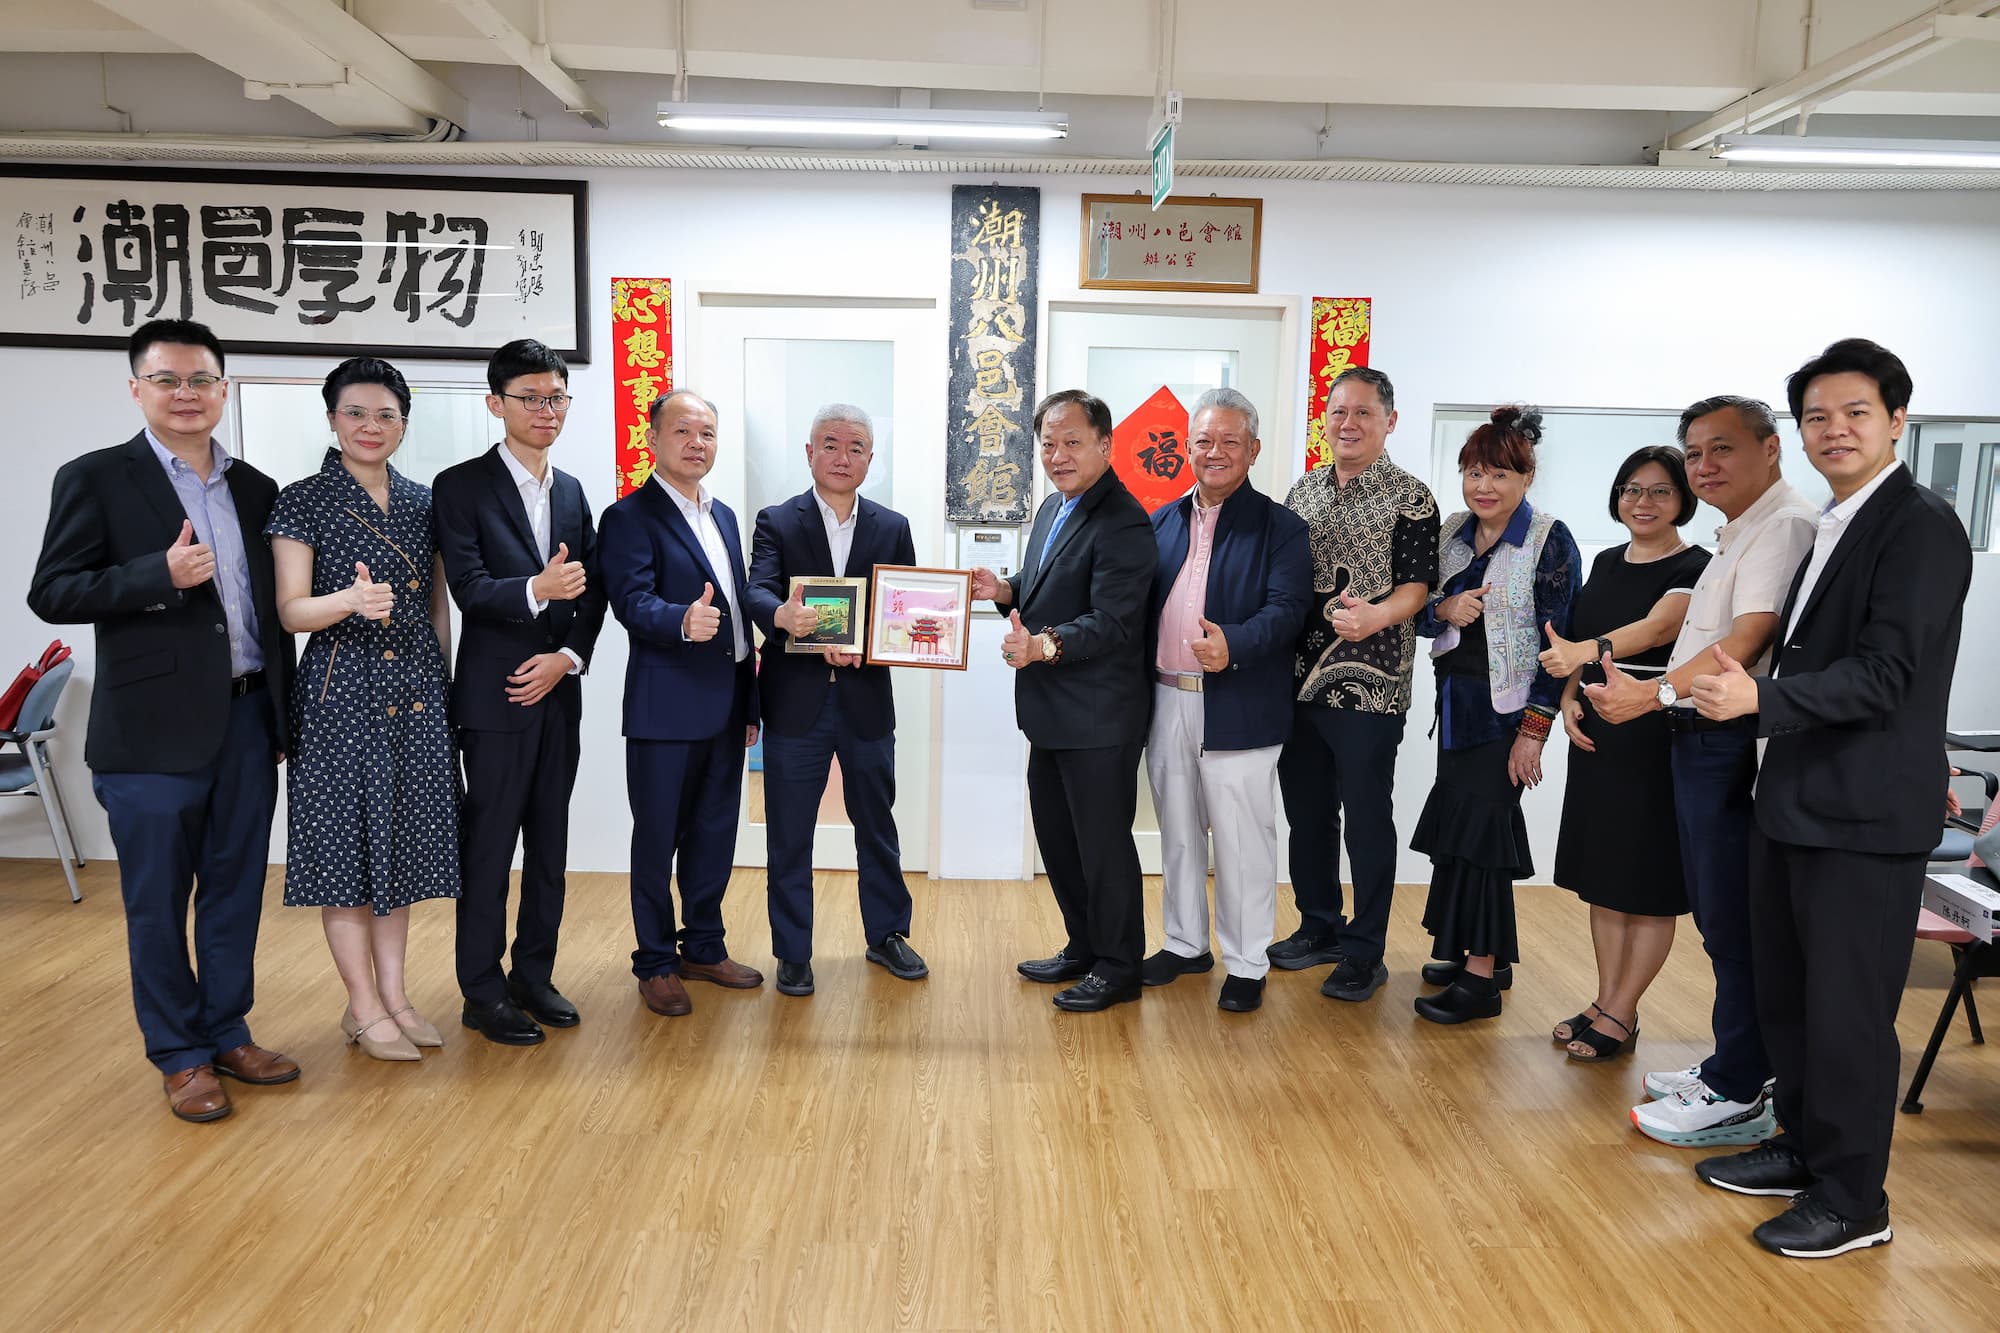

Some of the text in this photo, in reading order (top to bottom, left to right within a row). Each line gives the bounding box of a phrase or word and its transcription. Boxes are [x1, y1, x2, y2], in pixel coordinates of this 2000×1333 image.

[1101, 221, 1243, 243] 潮州八邑會館
[1144, 251, 1196, 268] 辦公室
[960, 200, 1025, 504] 潮州八邑會館
[1137, 431, 1184, 480] 福
